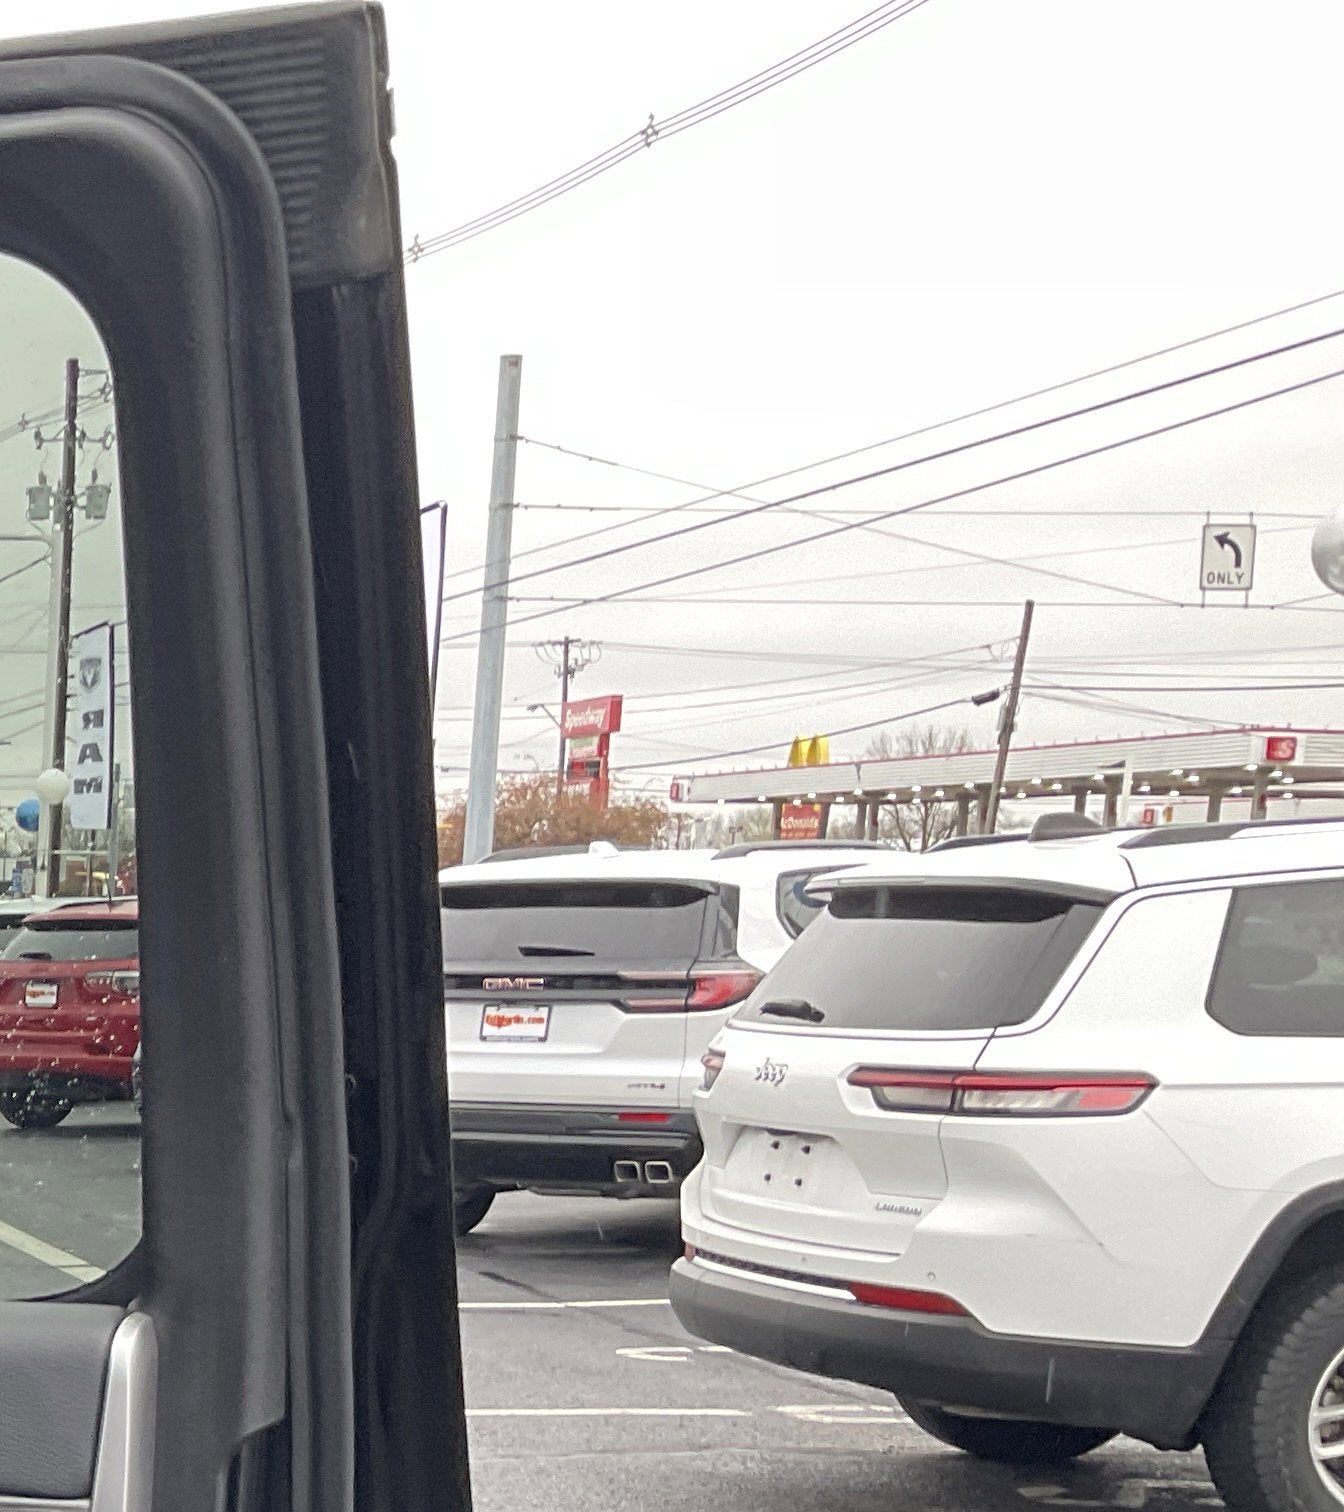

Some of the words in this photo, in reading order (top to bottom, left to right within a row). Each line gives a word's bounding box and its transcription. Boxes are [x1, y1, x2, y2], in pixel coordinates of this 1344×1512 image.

[1206, 571, 1245, 585] ONLY
[565, 706, 606, 732] Speedway
[482, 977, 545, 992] GMC
[754, 1056, 789, 1088] Jeep
